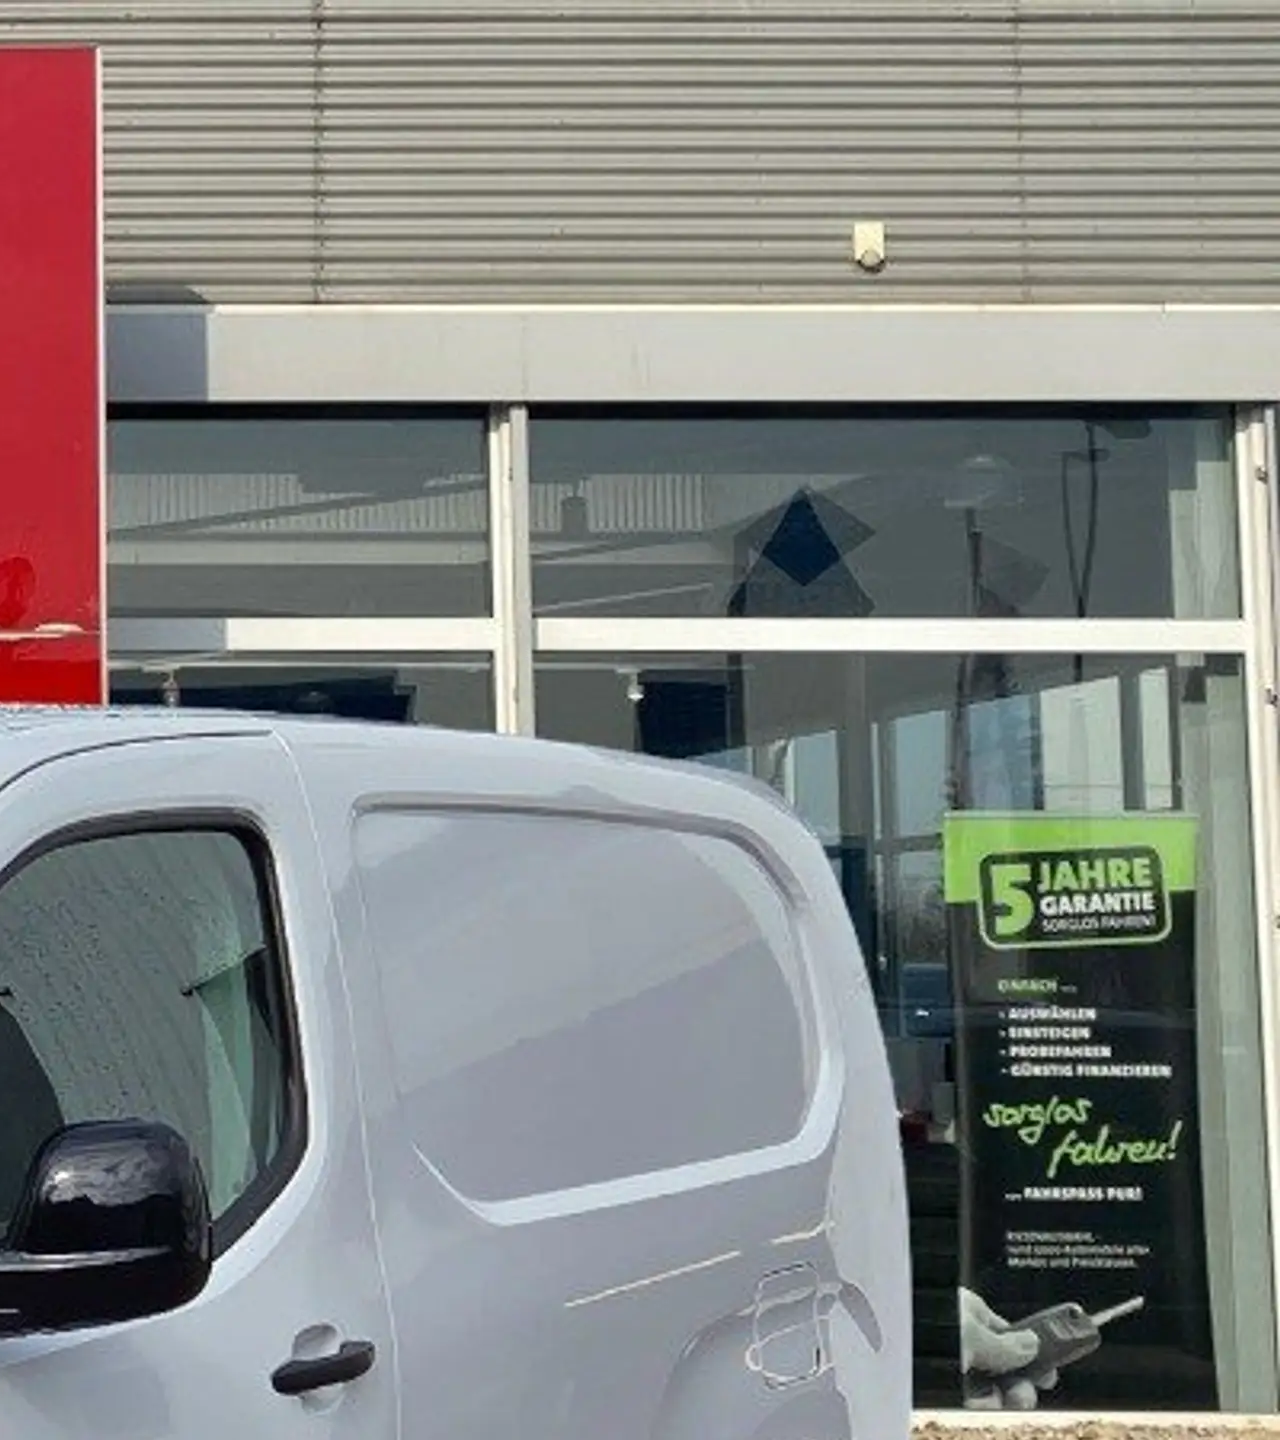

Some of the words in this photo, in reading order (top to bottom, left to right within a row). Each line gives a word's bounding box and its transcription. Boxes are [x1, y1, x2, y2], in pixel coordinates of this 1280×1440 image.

[991, 864, 1034, 936] 5
[1037, 857, 1153, 892] JAHRE
[1040, 892, 1156, 916] GARANTIE
[982, 1095, 1093, 1145] sorglos
[1046, 1119, 1183, 1179] fahren!
